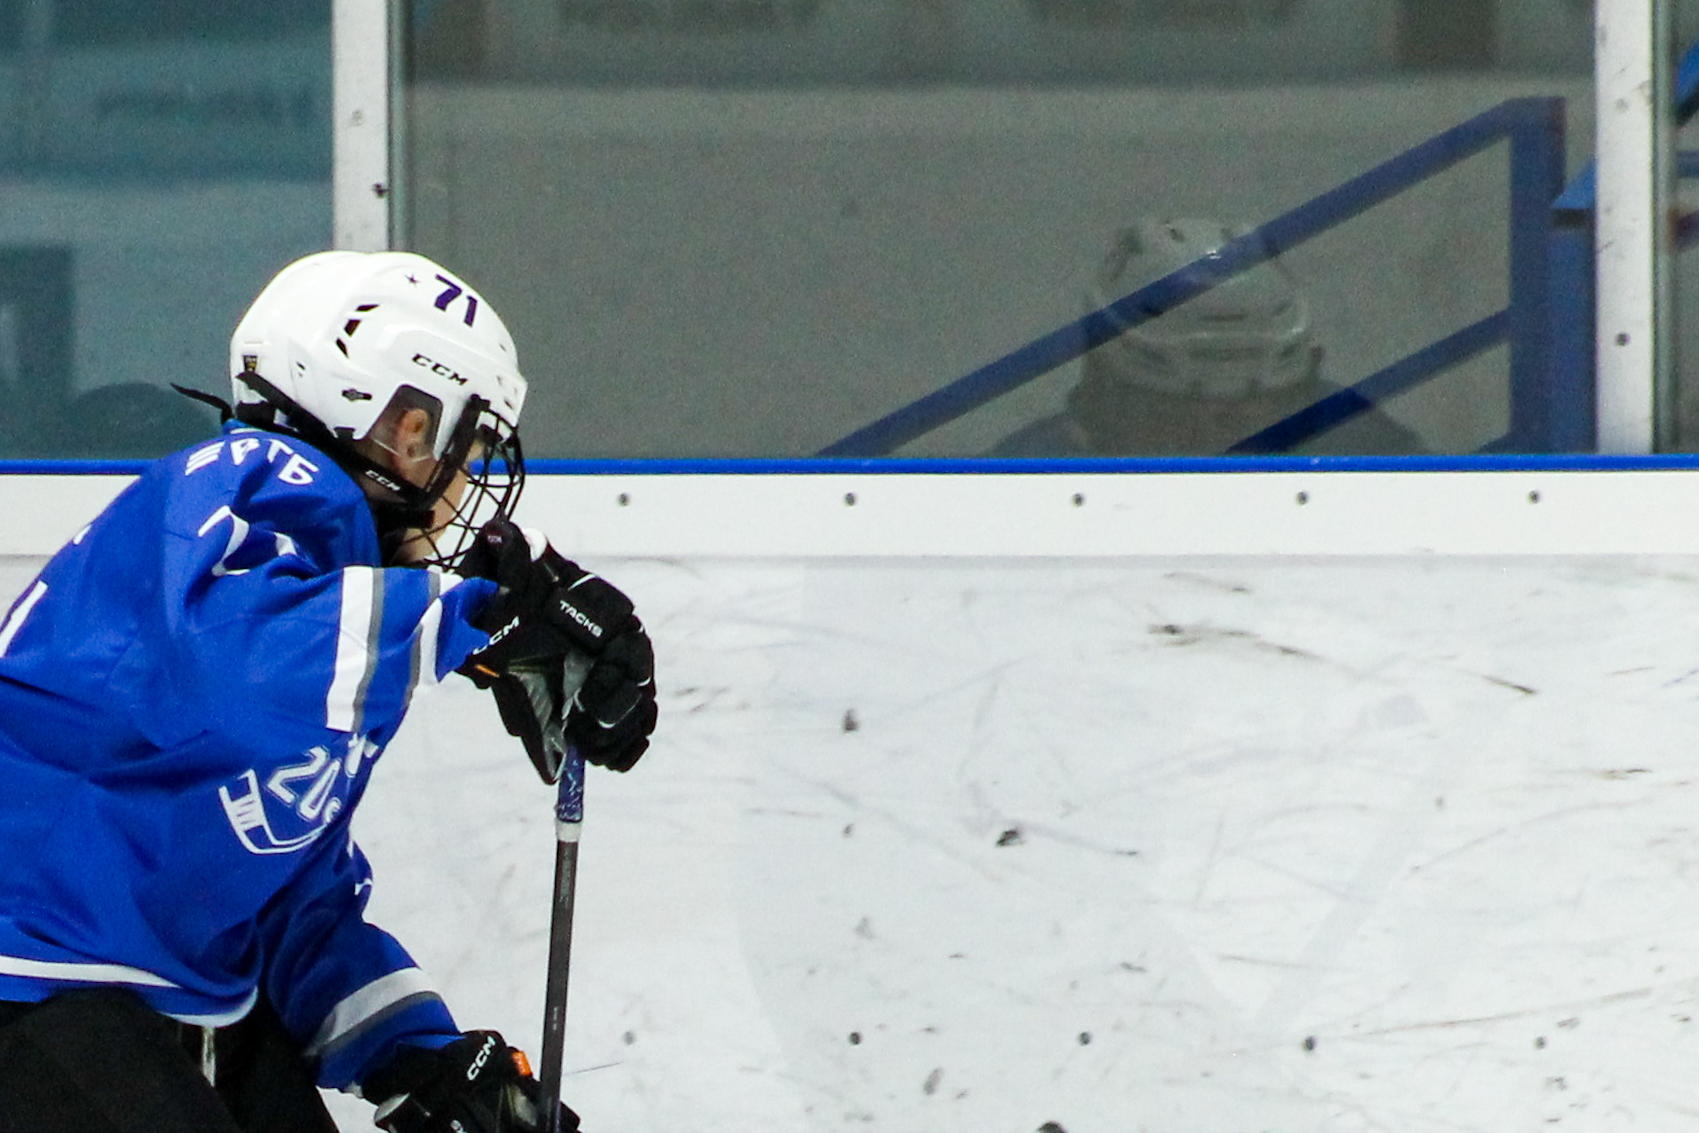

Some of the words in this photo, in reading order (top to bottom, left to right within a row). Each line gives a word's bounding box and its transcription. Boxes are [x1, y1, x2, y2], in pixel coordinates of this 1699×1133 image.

[434, 273, 478, 328] 71
[411, 353, 469, 387] CCM
[365, 469, 401, 492] CCM
[559, 600, 604, 639] TACKS
[466, 1035, 497, 1081] CCM
